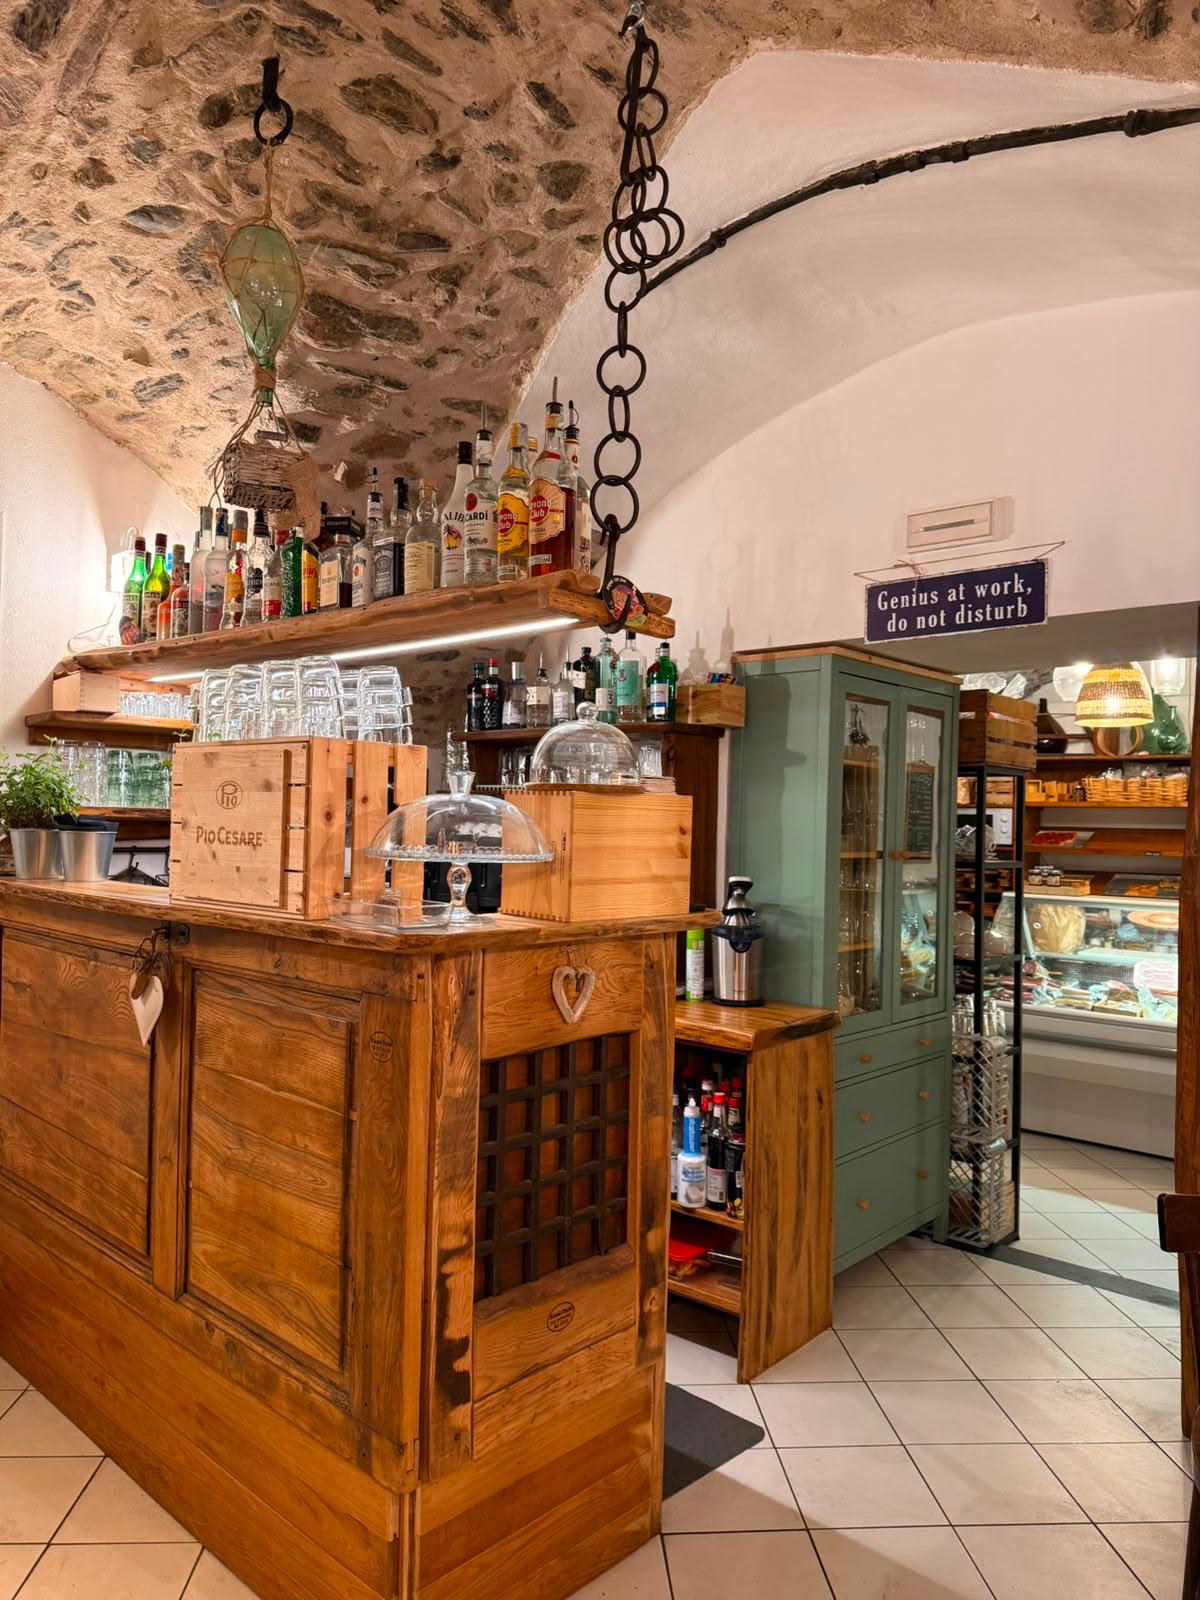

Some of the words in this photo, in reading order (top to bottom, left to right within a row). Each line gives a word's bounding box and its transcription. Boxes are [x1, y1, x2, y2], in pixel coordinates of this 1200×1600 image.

[877, 588, 938, 611] Genius
[947, 583, 966, 602] at
[975, 573, 1032, 597] work,
[887, 613, 908, 633] do
[916, 610, 947, 629] not
[955, 597, 1028, 625] disturb
